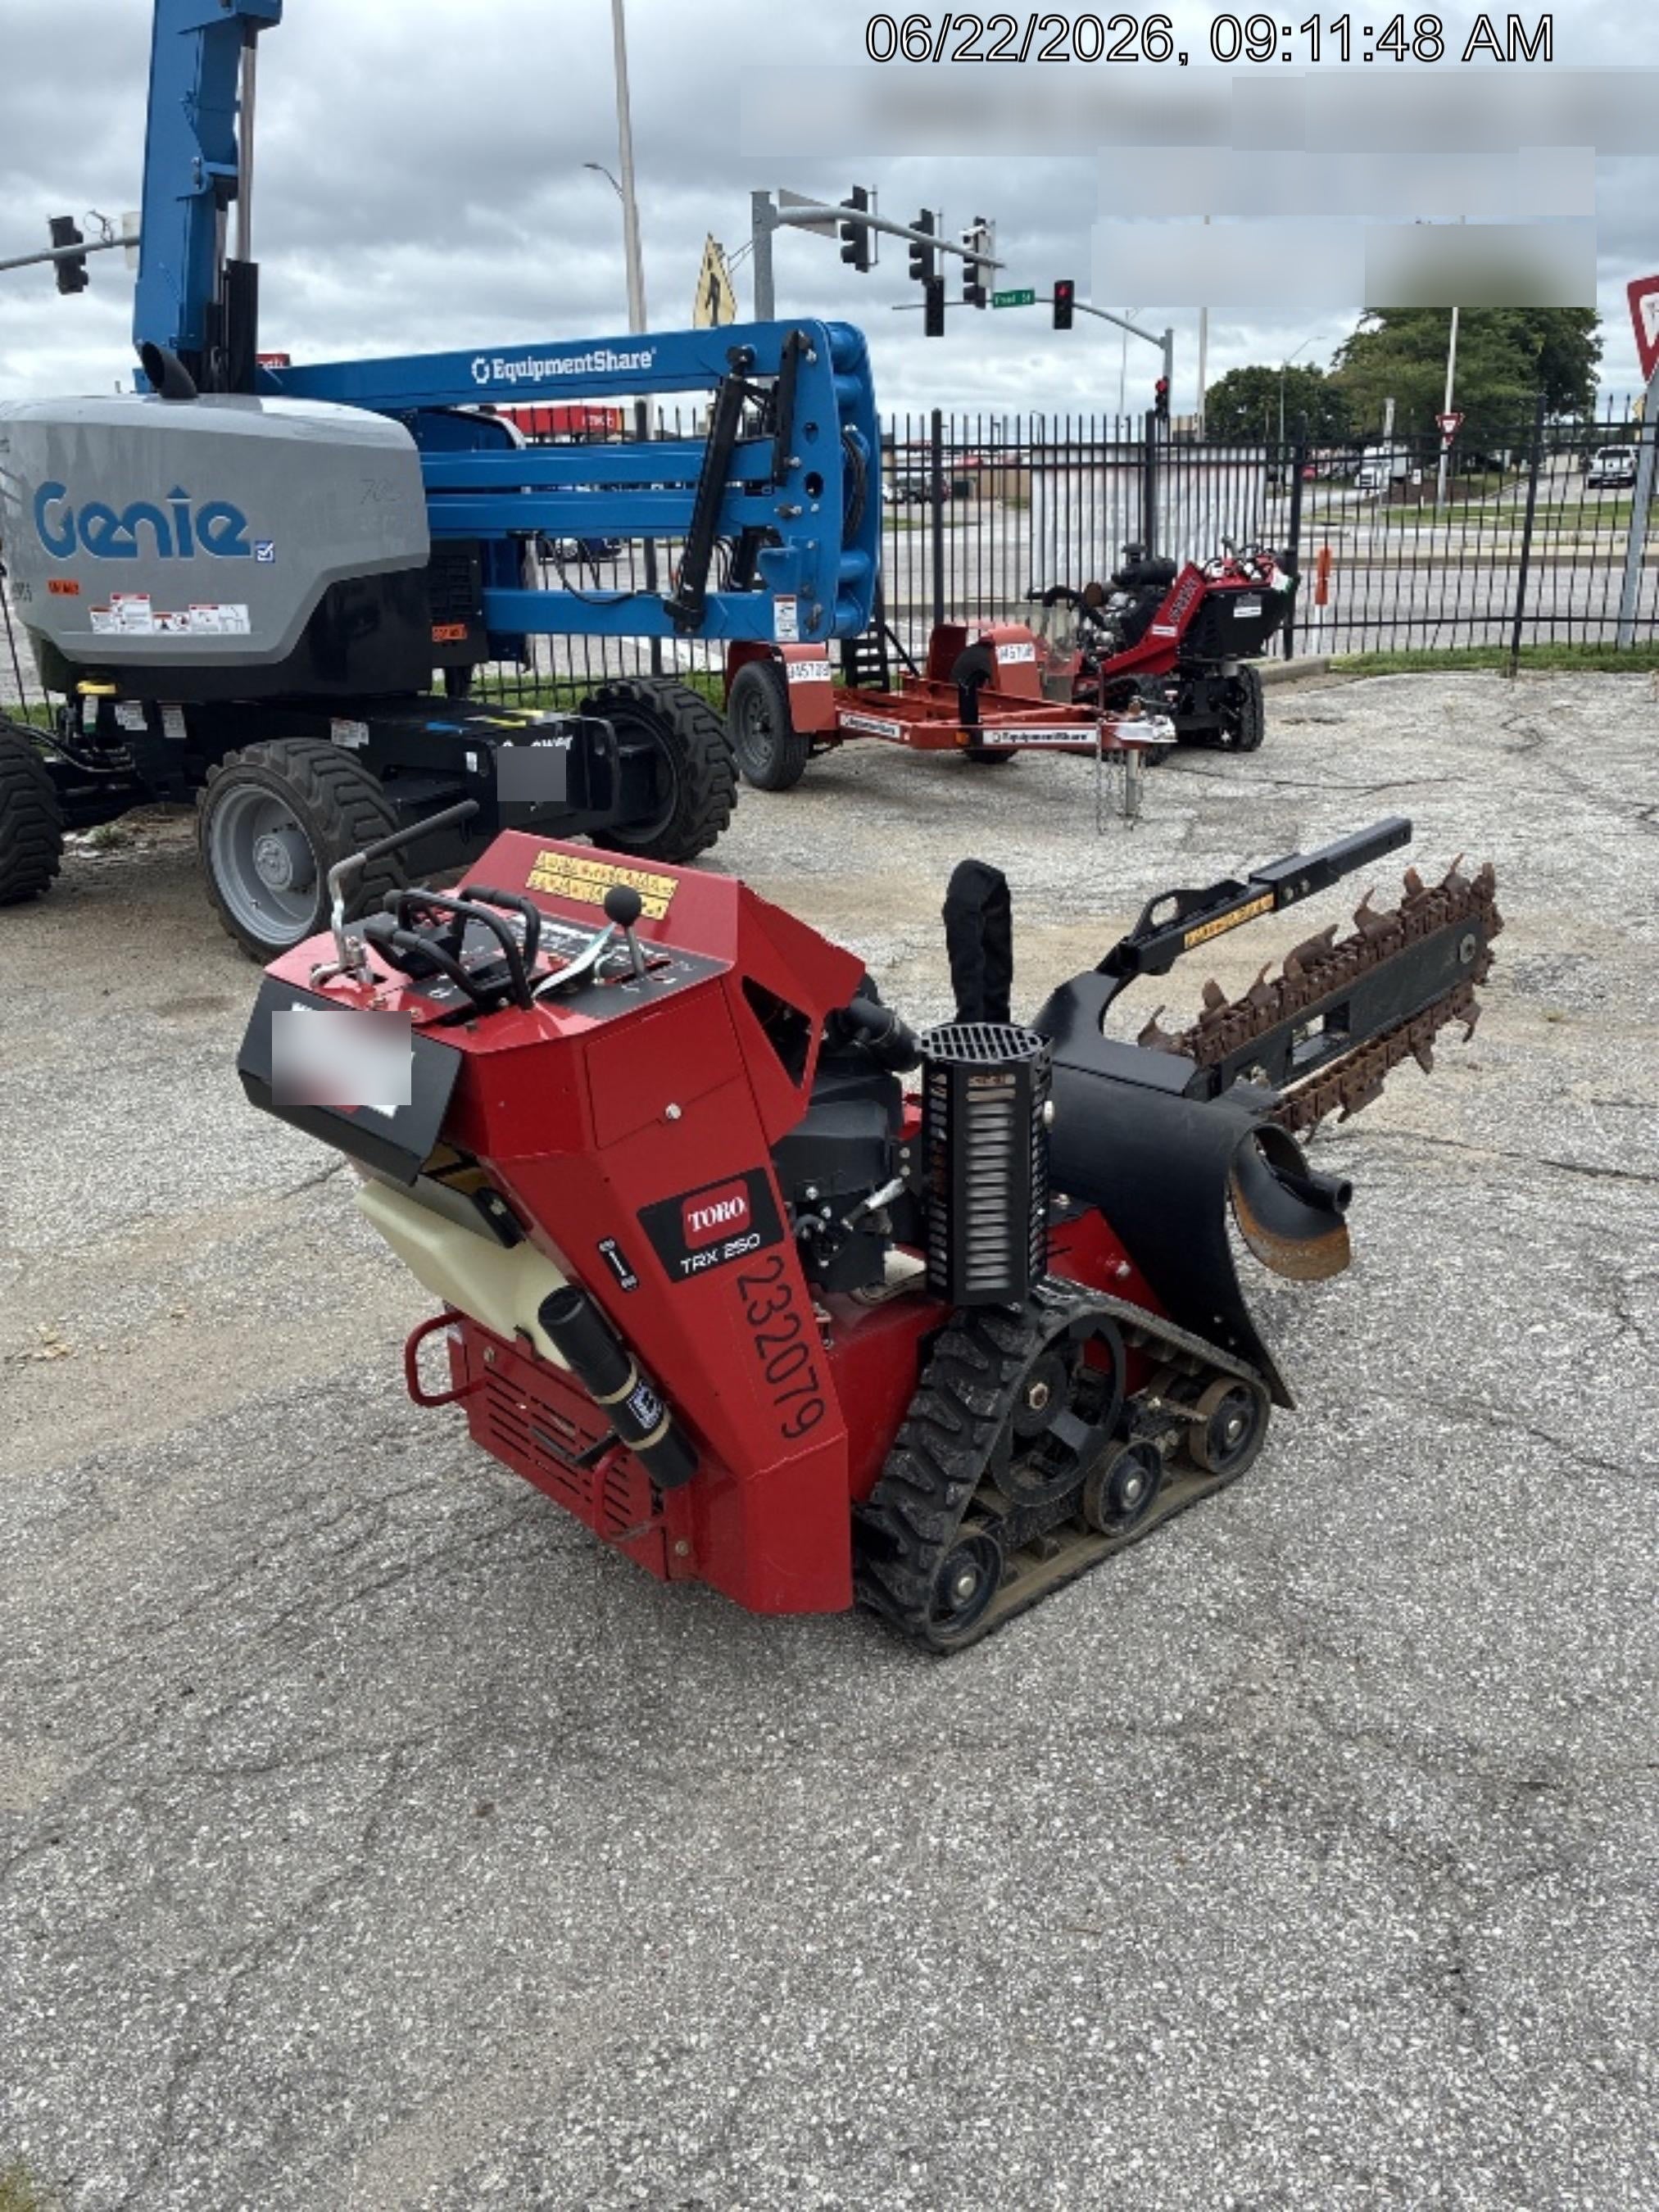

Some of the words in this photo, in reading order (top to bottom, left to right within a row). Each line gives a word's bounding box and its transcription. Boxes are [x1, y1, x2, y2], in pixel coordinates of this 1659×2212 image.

[493, 350, 653, 383] EquipmentShare
[34, 481, 253, 560] Genie
[687, 1196, 747, 1232] TORO
[681, 1248, 718, 1274] TRX
[724, 1233, 760, 1260] 250
[737, 1254, 826, 1439] 232079
